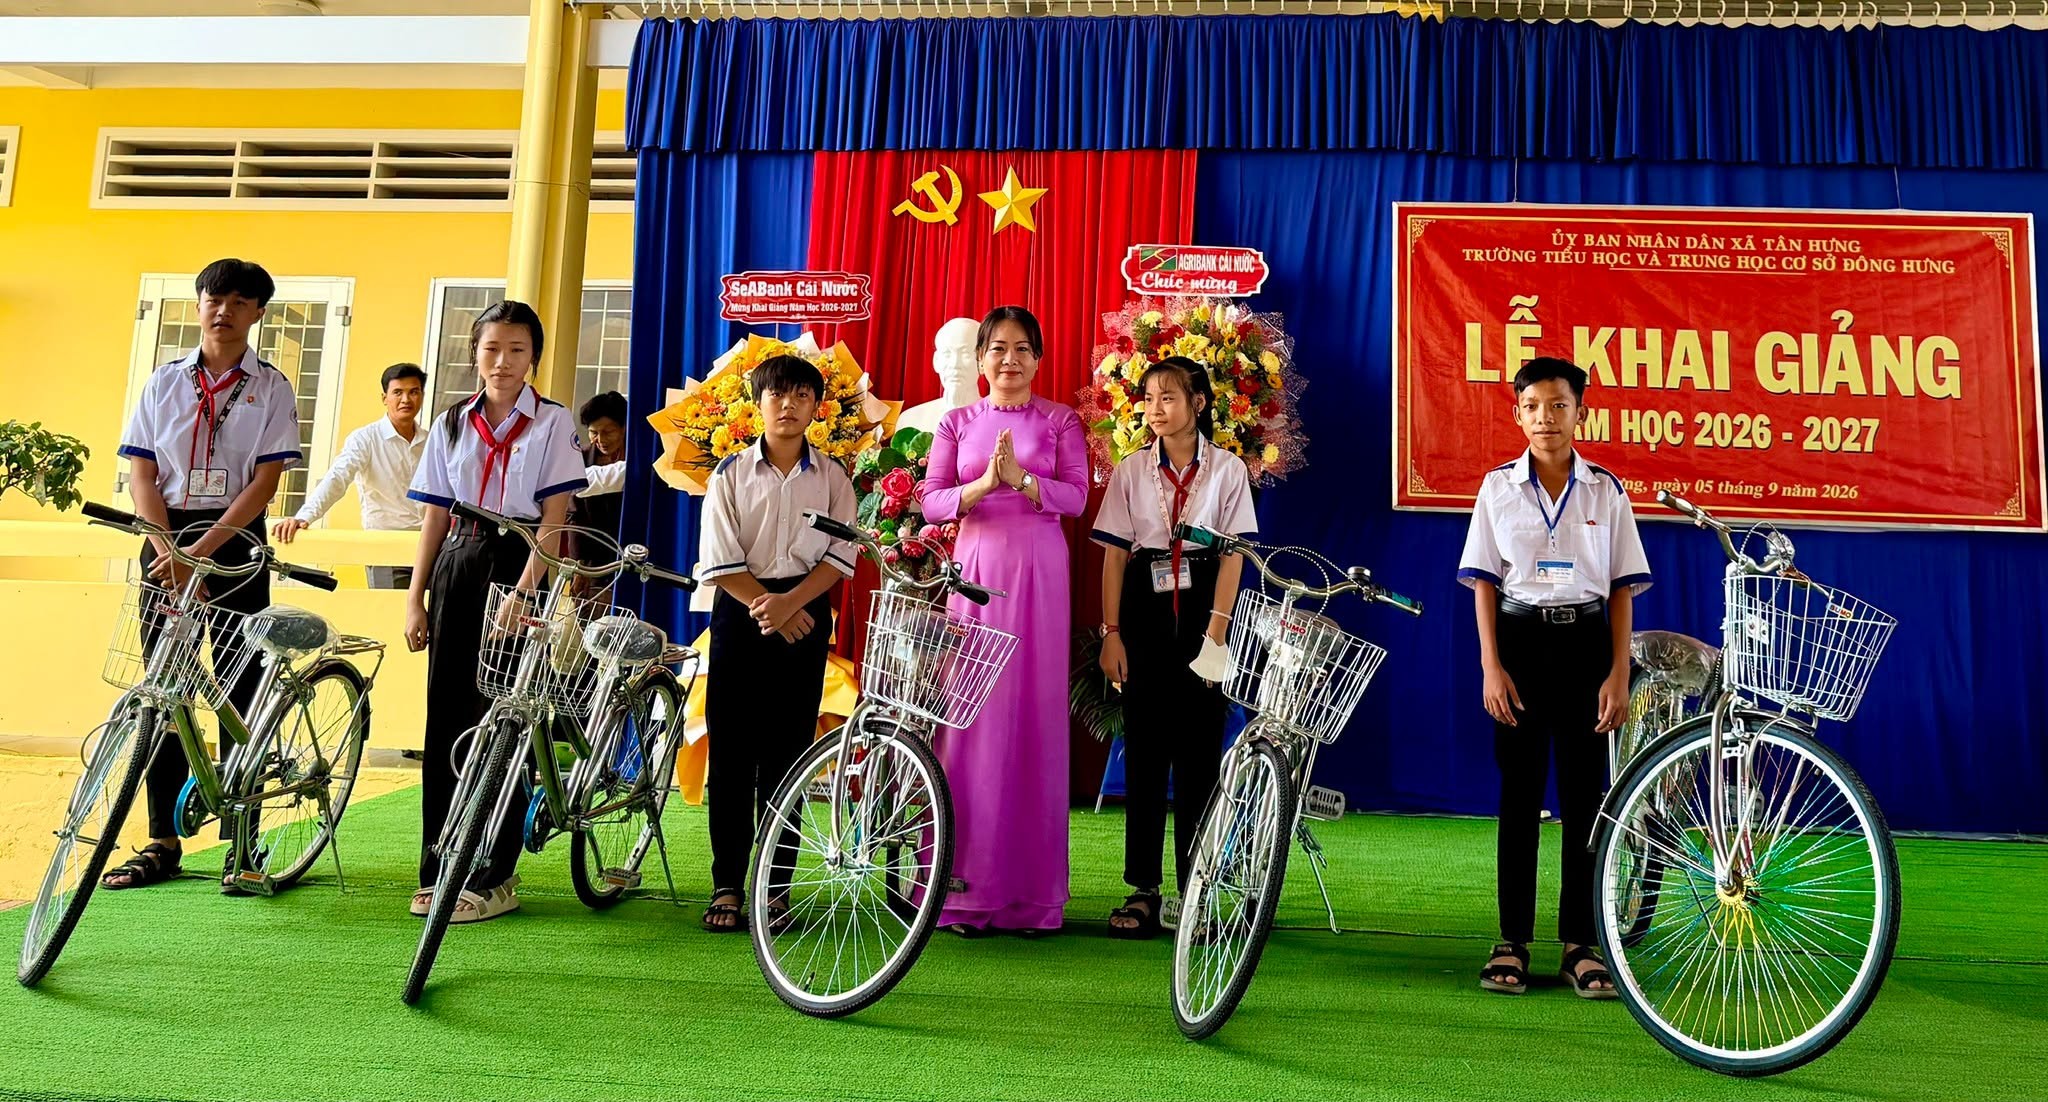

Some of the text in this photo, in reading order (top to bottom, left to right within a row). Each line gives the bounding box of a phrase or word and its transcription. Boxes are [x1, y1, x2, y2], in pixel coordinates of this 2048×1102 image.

[1552, 228, 1861, 253] ỦY BAN NHÂN DÂN XÃ TÂN HƯNG
[1178, 251, 1255, 273] AGRIBANK CÁI NƯỚC
[1462, 246, 1956, 274] TRƯỜNG TIỂU HỌC VÀ TRUNG HỌC CƠ SỞ ĐÔNG HƯNG
[731, 279, 858, 297] SeABank Cái Nước
[1141, 271, 1238, 294] Chúc mừng
[1465, 295, 1961, 399] LỄ KHAI GIẢNG
[1622, 409, 1684, 452] HỌC
[1694, 412, 1772, 450] 2026
[1803, 417, 1881, 453] 2027
[1695, 479, 1713, 493] 05
[1718, 481, 1763, 499] tháng
[1768, 482, 1778, 495] 9
[1782, 483, 1817, 497] năm
[1821, 485, 1859, 499] 2026
